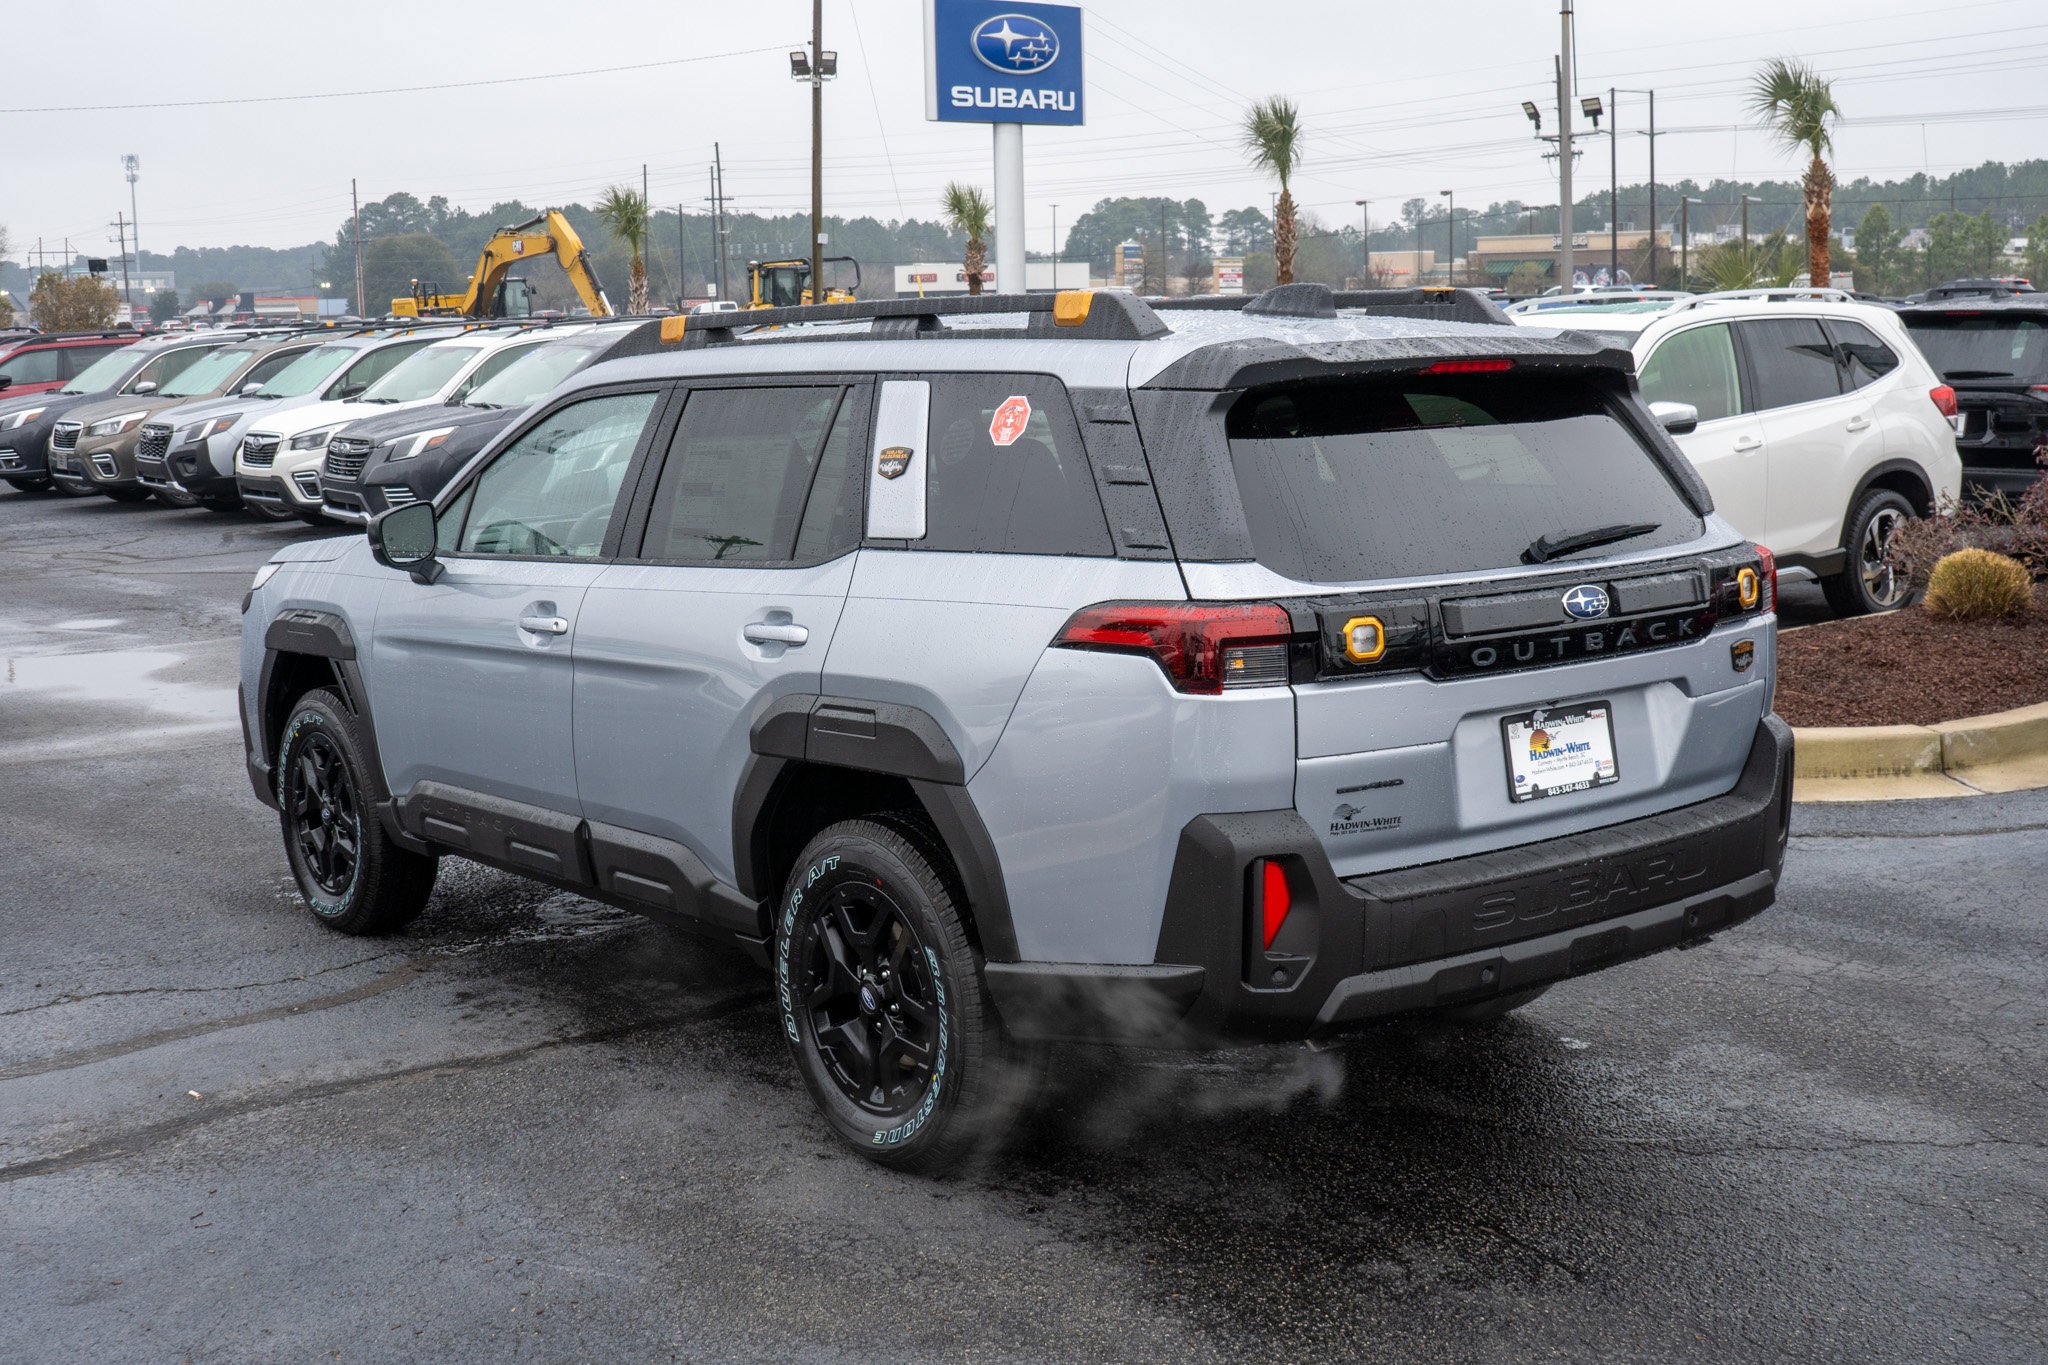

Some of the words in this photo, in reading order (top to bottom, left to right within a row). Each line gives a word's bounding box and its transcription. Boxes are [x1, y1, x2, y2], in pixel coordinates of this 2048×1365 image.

[951, 85, 1076, 112] SUBARU
[1471, 617, 1696, 667] OUTBACK
[1533, 715, 1586, 730] HADWIN-WHITE
[1529, 742, 1592, 761] HADWIN-WHITE
[1547, 780, 1590, 796] 843-347-4633
[1330, 816, 1402, 831] HADWIN-WHITE
[808, 855, 841, 889] A/T
[1473, 846, 1707, 931] SUBARU
[779, 887, 804, 1043] DUELER
[872, 945, 949, 1145] BRIDGESTONE
